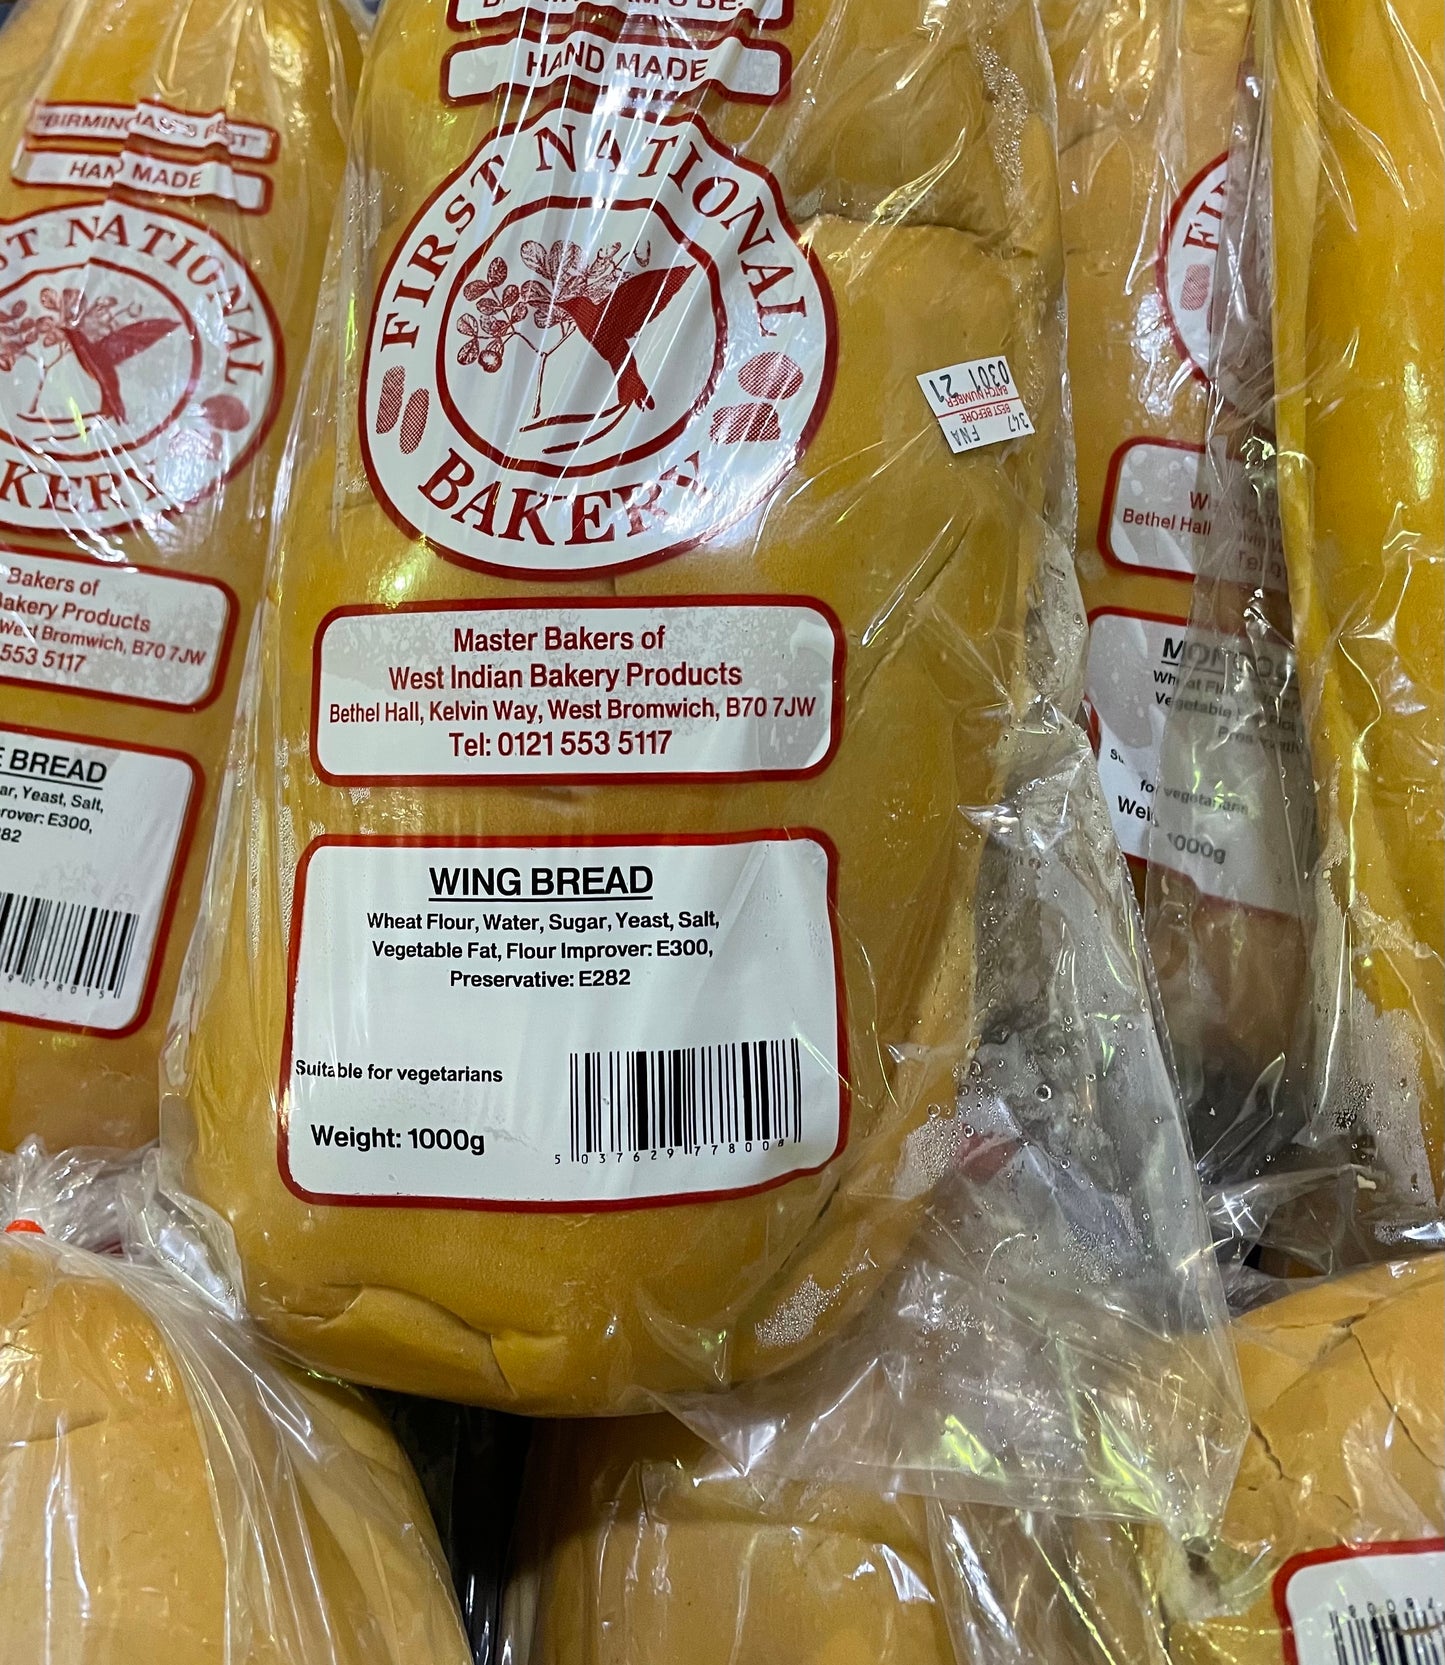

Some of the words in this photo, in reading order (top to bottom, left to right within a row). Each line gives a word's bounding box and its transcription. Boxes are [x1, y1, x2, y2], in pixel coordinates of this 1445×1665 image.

[526, 40, 604, 78] HAND
[615, 52, 709, 82] MADE
[132, 163, 202, 188] MADE
[380, 153, 514, 352] FIRST
[533, 123, 809, 338] NATIONAL
[66, 214, 264, 384] NATIONAL
[929, 374, 959, 403] 21
[968, 360, 1010, 390] 0301
[945, 390, 985, 408] NUMBER
[985, 385, 1009, 400] BATCH
[959, 407, 993, 423] BEFORE
[994, 403, 1011, 416] BEST
[1007, 412, 1029, 433] 347
[950, 424, 980, 446] FNA
[417, 448, 709, 546] BAKERY
[1122, 508, 1176, 531] Bethel
[7, 567, 75, 594] Bakers
[80, 579, 101, 597] of
[62, 602, 151, 633] Products
[42, 625, 127, 655] Bromwich,
[132, 640, 166, 660] B70
[170, 647, 207, 666] 7JW
[454, 627, 538, 652] Master
[544, 626, 634, 651] Bakers
[641, 625, 666, 650] of
[0, 643, 38, 666] 553
[42, 650, 86, 673] 5117
[388, 665, 444, 691] West
[451, 663, 523, 689] Indian
[530, 662, 620, 692] Bakery
[626, 661, 743, 687] Products
[329, 702, 380, 723] Bethel
[385, 701, 425, 725] Hall,
[429, 700, 488, 722] Kelvin
[493, 700, 543, 724] Way,
[547, 699, 602, 720] West
[607, 697, 720, 721] Bromwich,
[726, 696, 767, 718] B70
[773, 696, 817, 718] 7JW
[449, 731, 491, 757] Tel:
[498, 731, 553, 757] 0121
[560, 730, 611, 757] 553
[617, 730, 673, 755] 5117
[9, 748, 108, 783] BREAD
[23, 786, 66, 807] Yeast,
[71, 794, 104, 814] Salt,
[47, 813, 92, 834] E300,
[429, 867, 521, 896] WING
[531, 866, 653, 896] BREAD
[367, 912, 422, 929] Wheat
[427, 914, 479, 933] Flour,
[483, 914, 544, 934] Water,
[549, 913, 612, 933] Sugar,
[615, 912, 674, 931] Yeast,
[678, 910, 720, 929] Salt,
[372, 940, 462, 960] Vegetable
[467, 942, 502, 962] Fat,
[507, 942, 556, 959] Flour
[561, 942, 652, 962] Improver:
[656, 939, 713, 958] E300,
[450, 970, 574, 988] Preservative:
[579, 969, 631, 987] E282
[296, 1059, 363, 1079] Suitable
[368, 1064, 393, 1080] for
[397, 1066, 503, 1085] vegetarians
[311, 1124, 401, 1152] Weight:
[407, 1128, 485, 1156] 1000g
